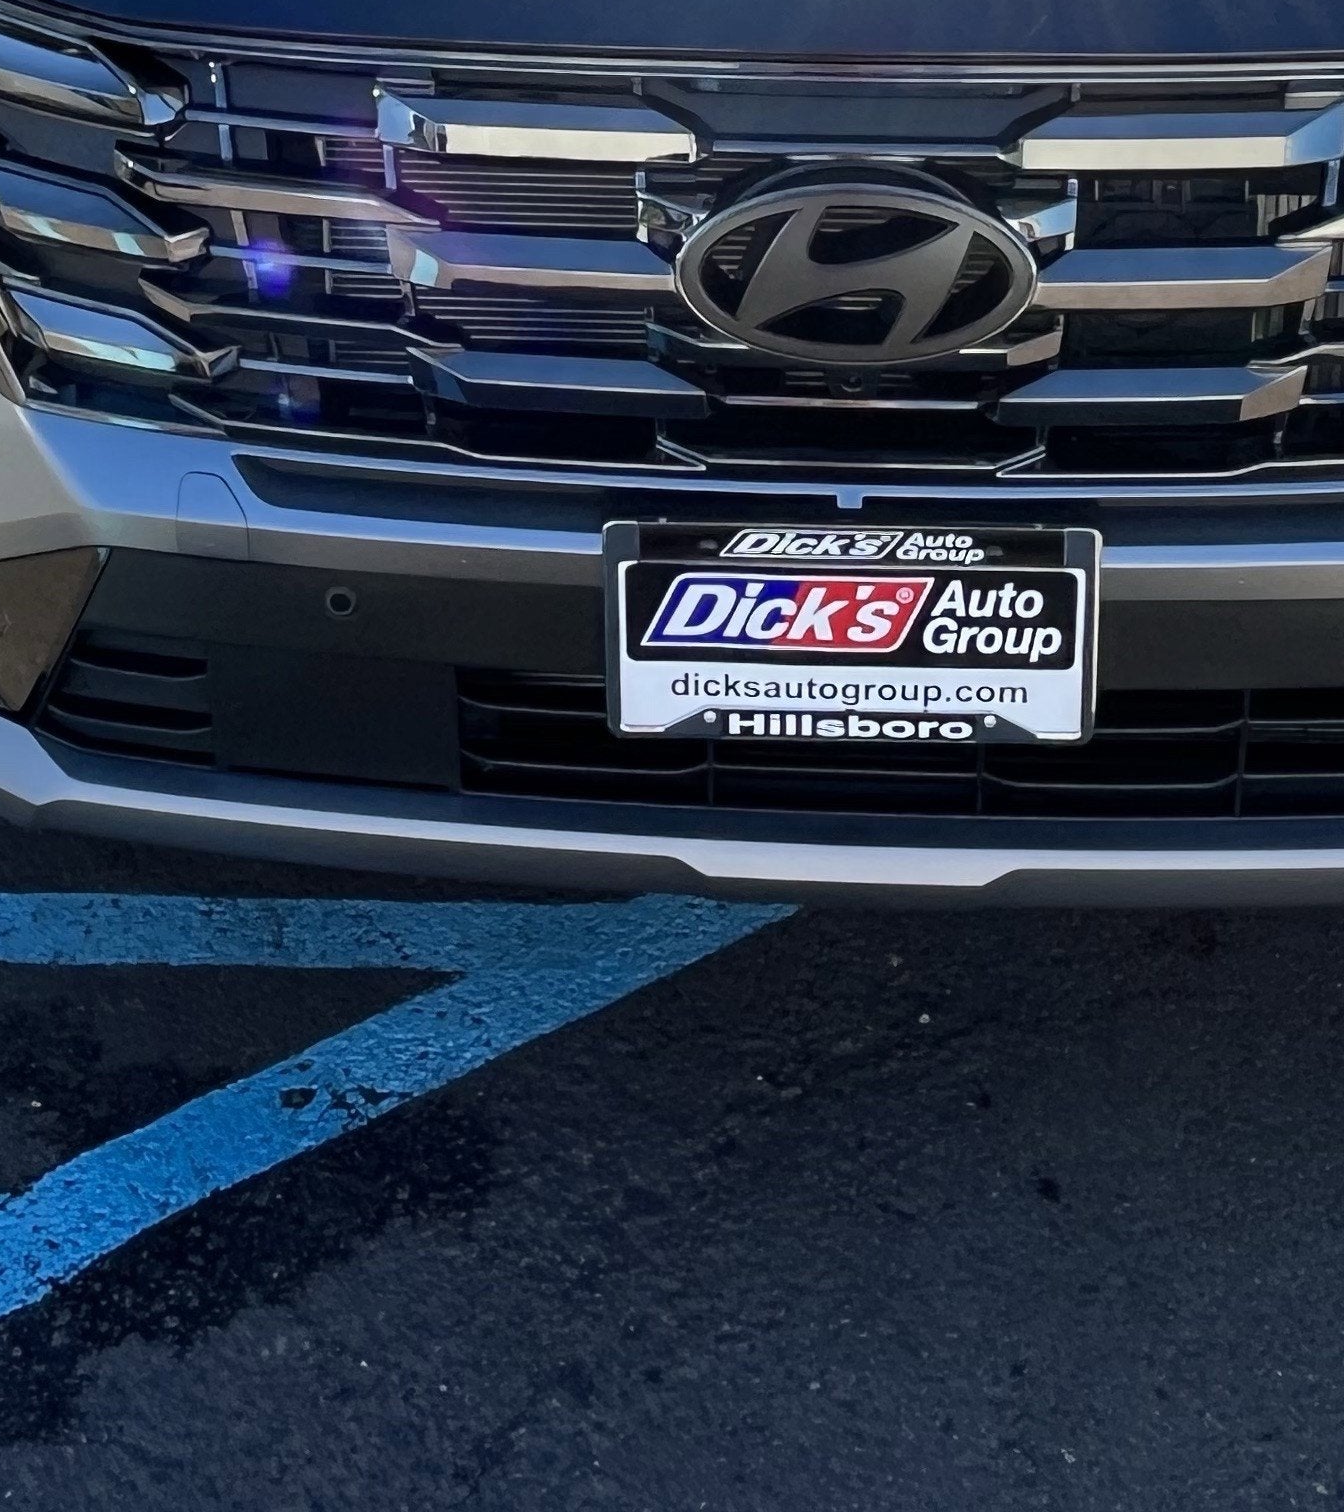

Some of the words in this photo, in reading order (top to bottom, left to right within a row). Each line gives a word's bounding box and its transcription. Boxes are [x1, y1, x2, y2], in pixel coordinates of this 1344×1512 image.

[732, 532, 885, 557] Dick's
[906, 531, 974, 549] Auto
[895, 545, 985, 566] Group
[662, 582, 900, 644] Dick's
[929, 579, 1045, 620] Auto
[922, 618, 1063, 663] Group
[670, 672, 1029, 707] dicksautogroup.com
[728, 712, 974, 741] Hillsboro
